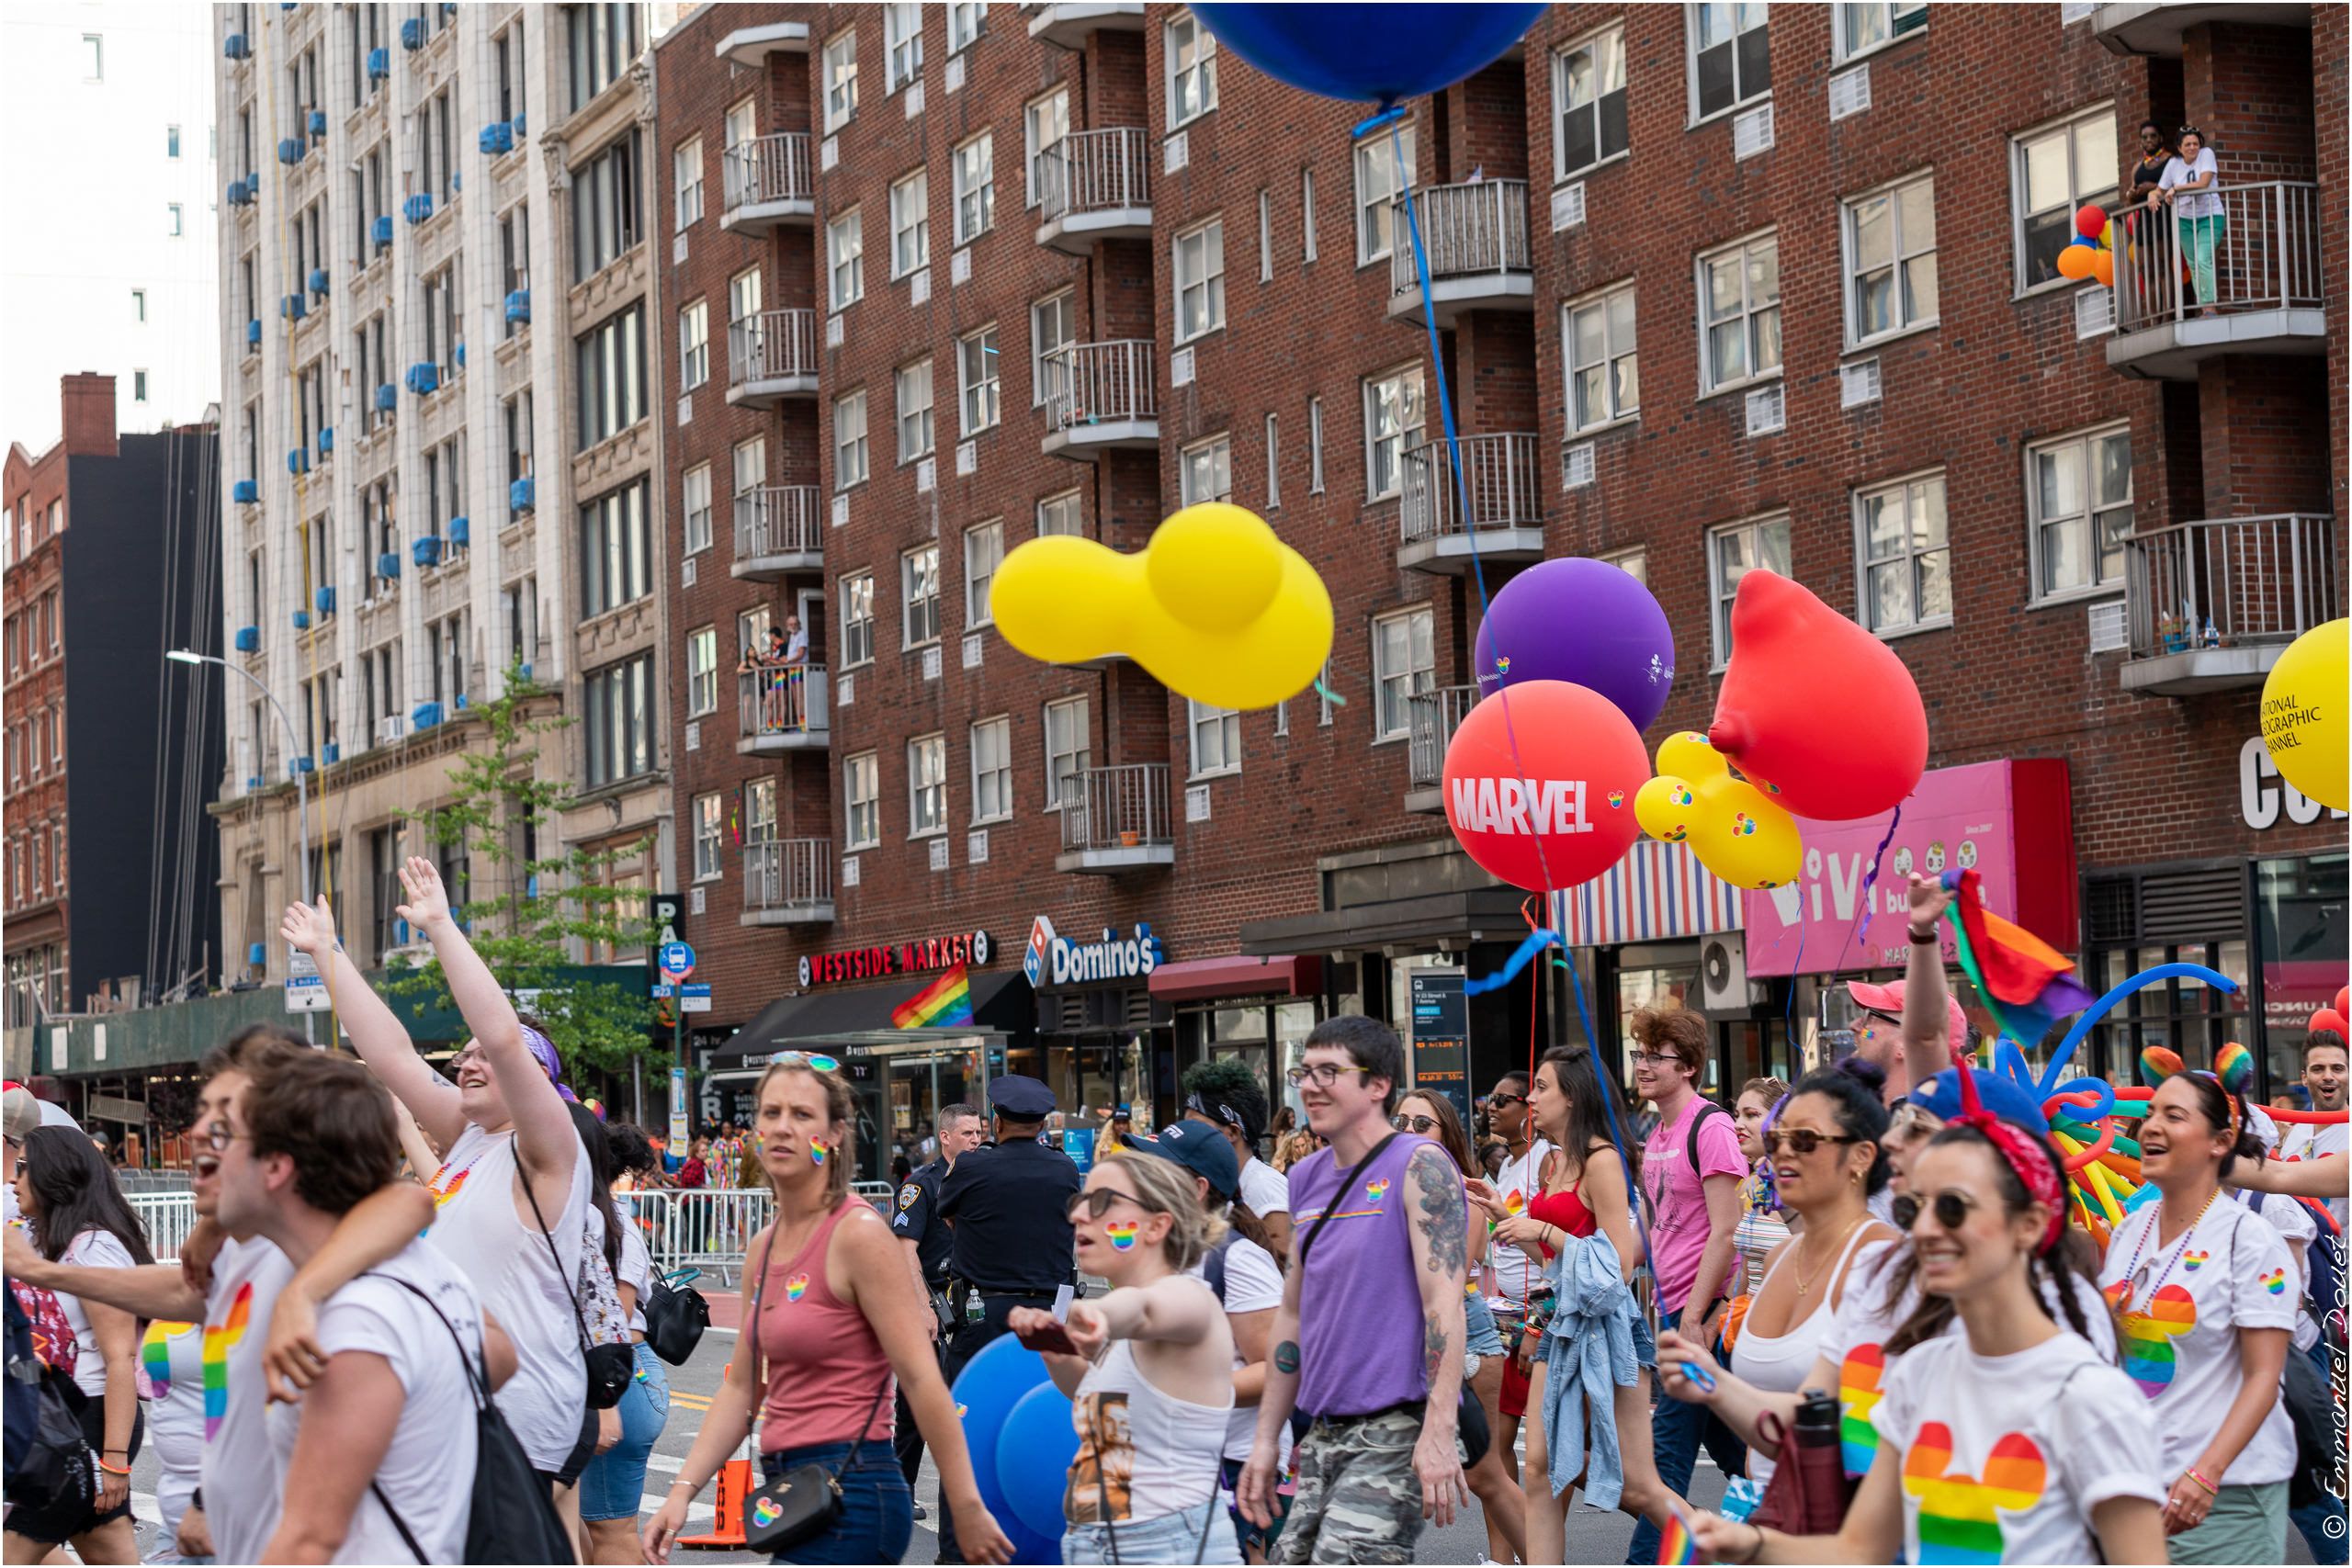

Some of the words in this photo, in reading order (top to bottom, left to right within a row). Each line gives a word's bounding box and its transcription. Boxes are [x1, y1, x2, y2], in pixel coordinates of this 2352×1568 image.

[1452, 777, 1594, 835] MARVEL
[810, 945, 893, 983] WESTSIDE
[902, 933, 974, 972] MARKET
[1051, 923, 1159, 985] Domino's
[694, 1035, 707, 1046] 24
